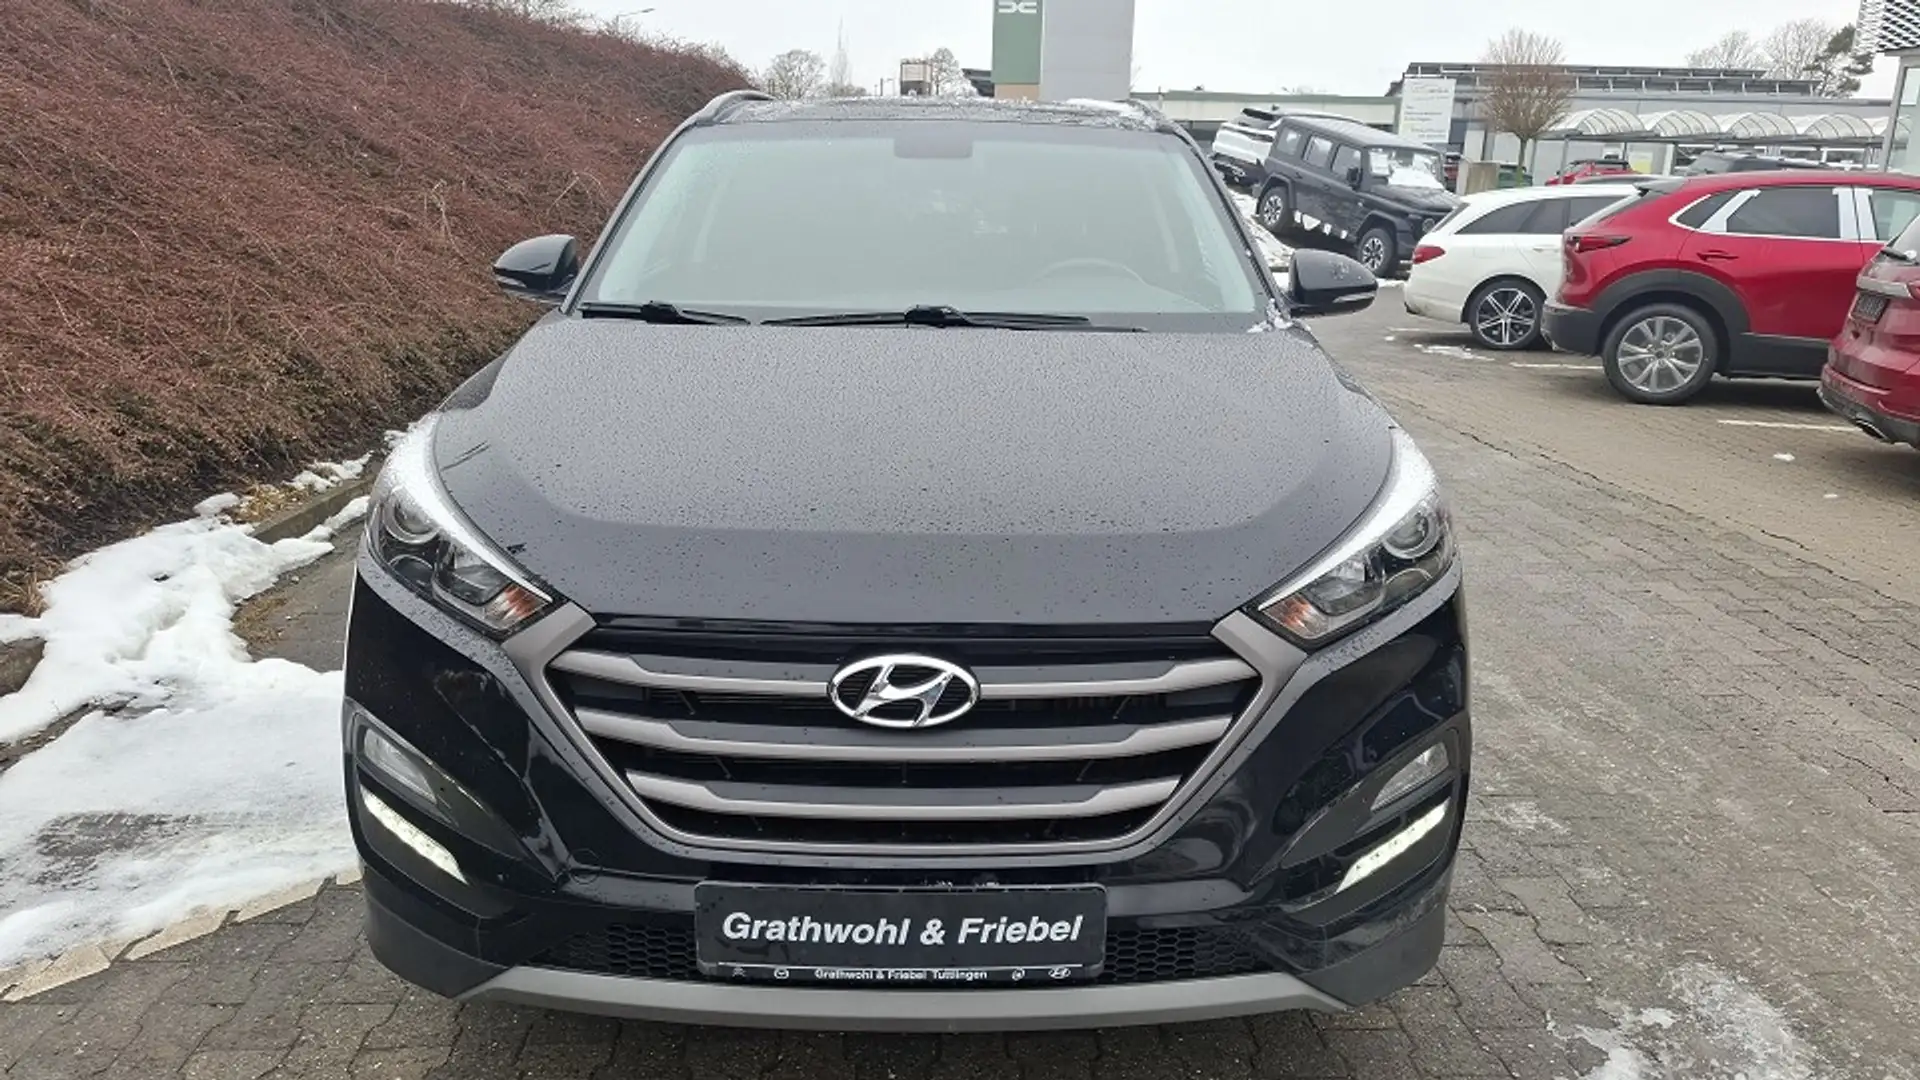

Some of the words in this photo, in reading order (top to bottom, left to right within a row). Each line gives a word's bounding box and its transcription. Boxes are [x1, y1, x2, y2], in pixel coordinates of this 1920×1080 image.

[722, 911, 910, 946] Grathwohl
[920, 918, 946, 946] &
[957, 915, 1083, 945] Friebel
[814, 969, 874, 980] Grathwohl
[876, 969, 886, 980] &
[887, 969, 927, 980] Friebel
